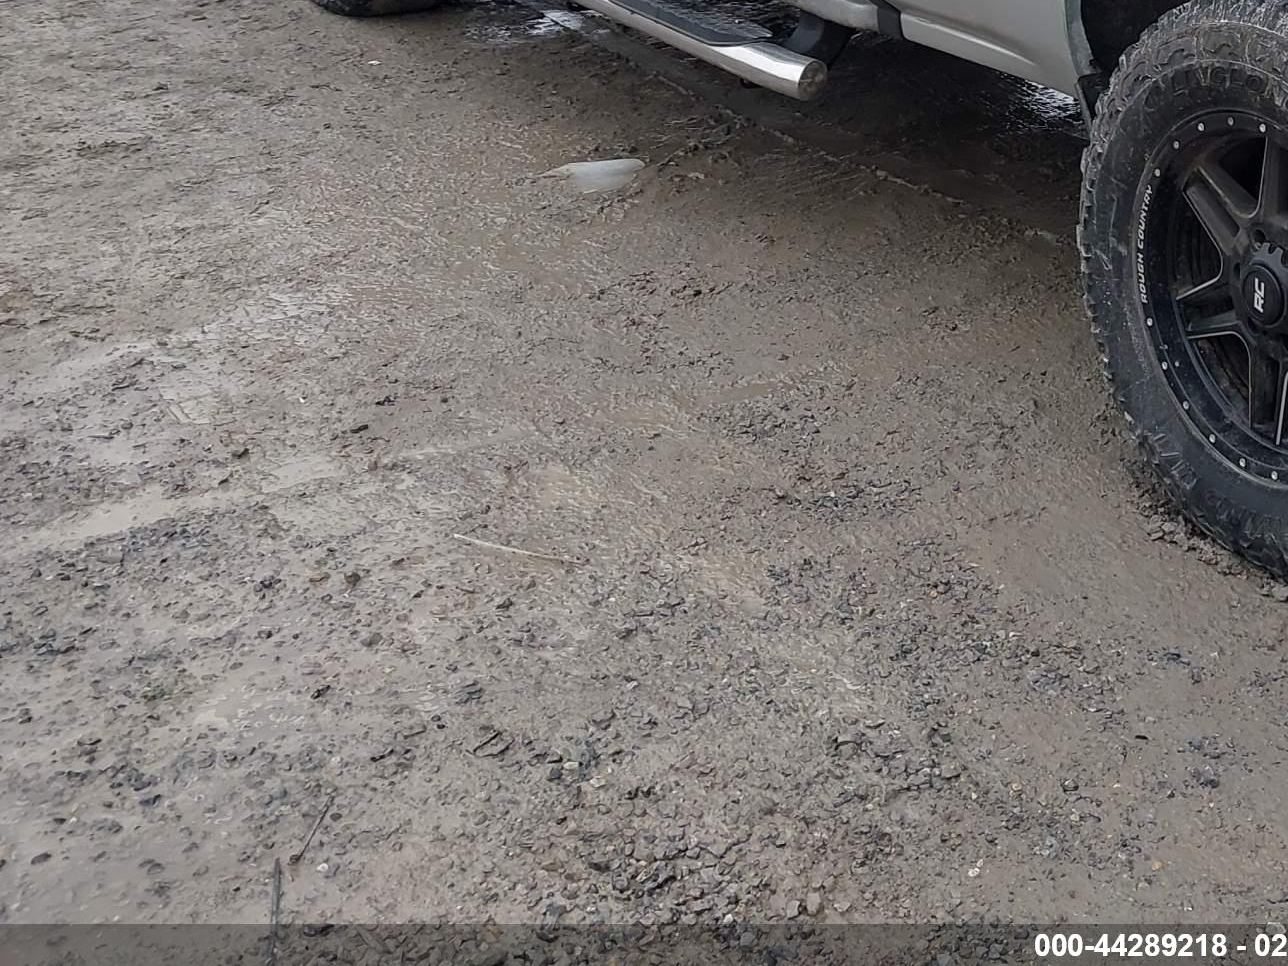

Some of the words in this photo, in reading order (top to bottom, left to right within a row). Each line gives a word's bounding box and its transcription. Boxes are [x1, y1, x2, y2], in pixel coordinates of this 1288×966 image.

[1137, 184, 1153, 250] COUNTRY
[1137, 252, 1149, 305] ROUGH
[1253, 277, 1265, 313] RC
